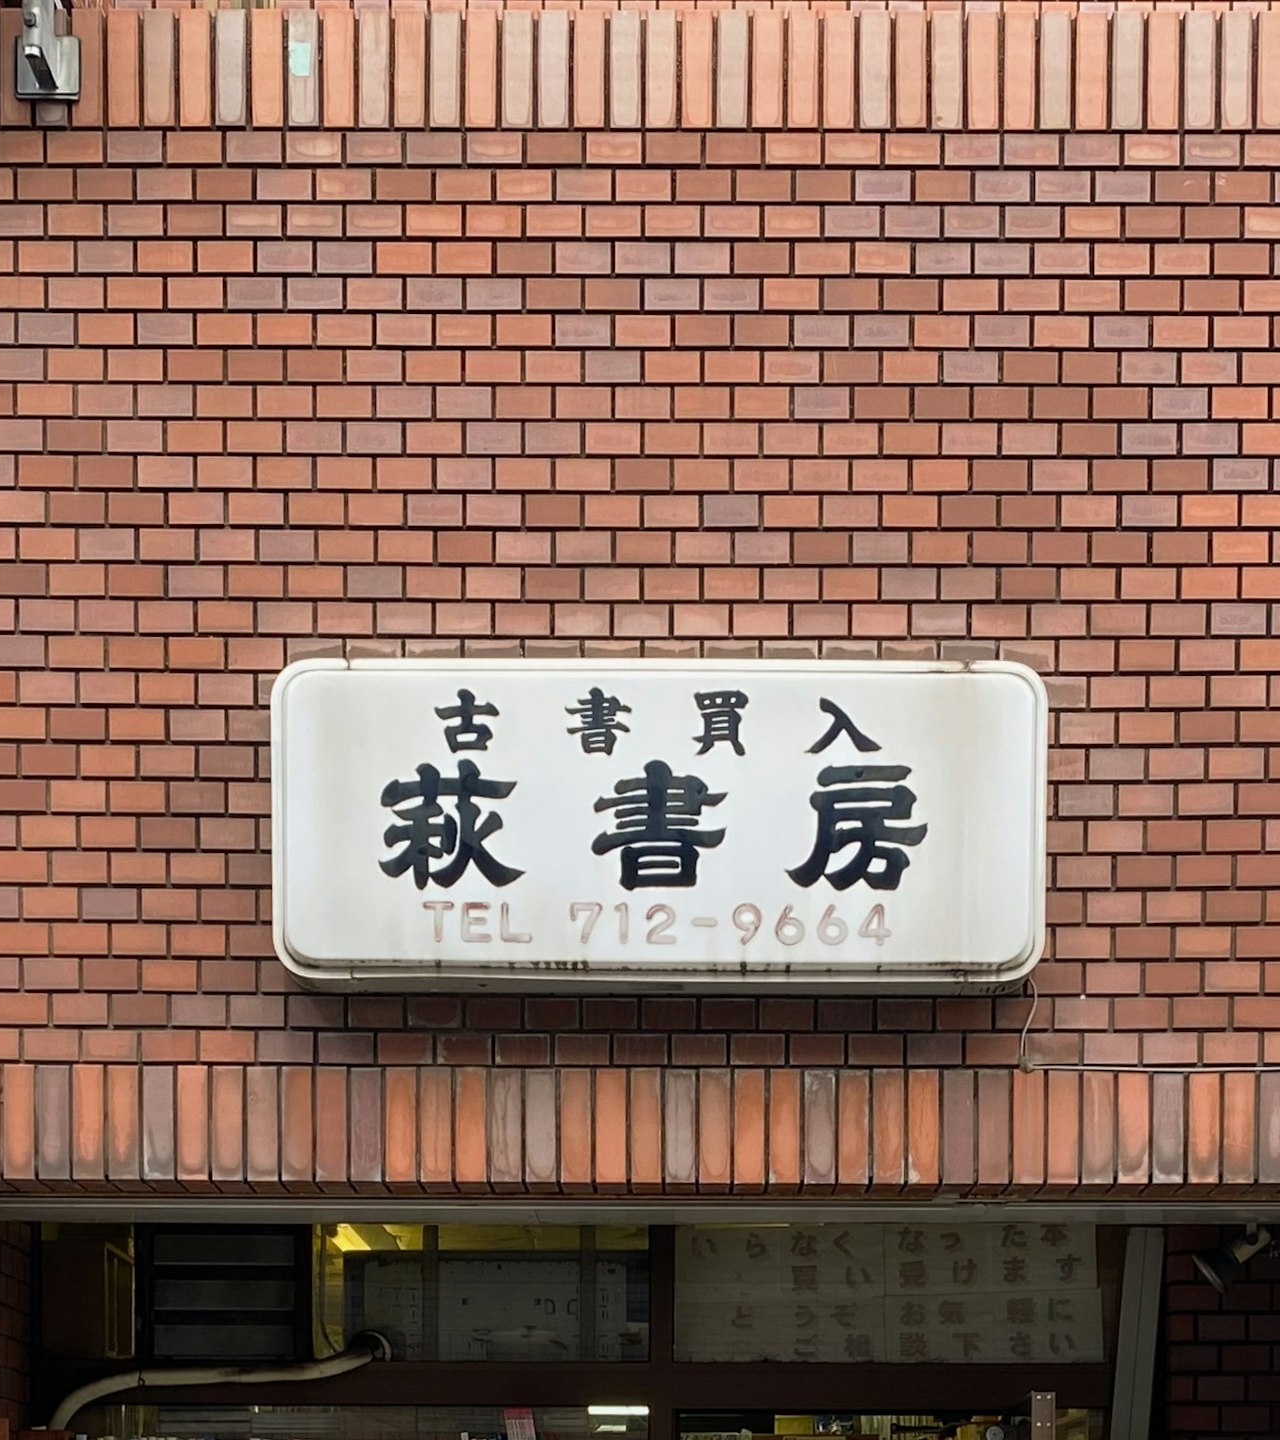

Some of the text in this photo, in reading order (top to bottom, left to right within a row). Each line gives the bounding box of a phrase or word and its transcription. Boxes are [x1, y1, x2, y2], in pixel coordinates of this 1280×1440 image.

[434, 687, 882, 756] 古書買入
[378, 759, 928, 891] 萩書房
[424, 900, 891, 946] TEL 712-9664
